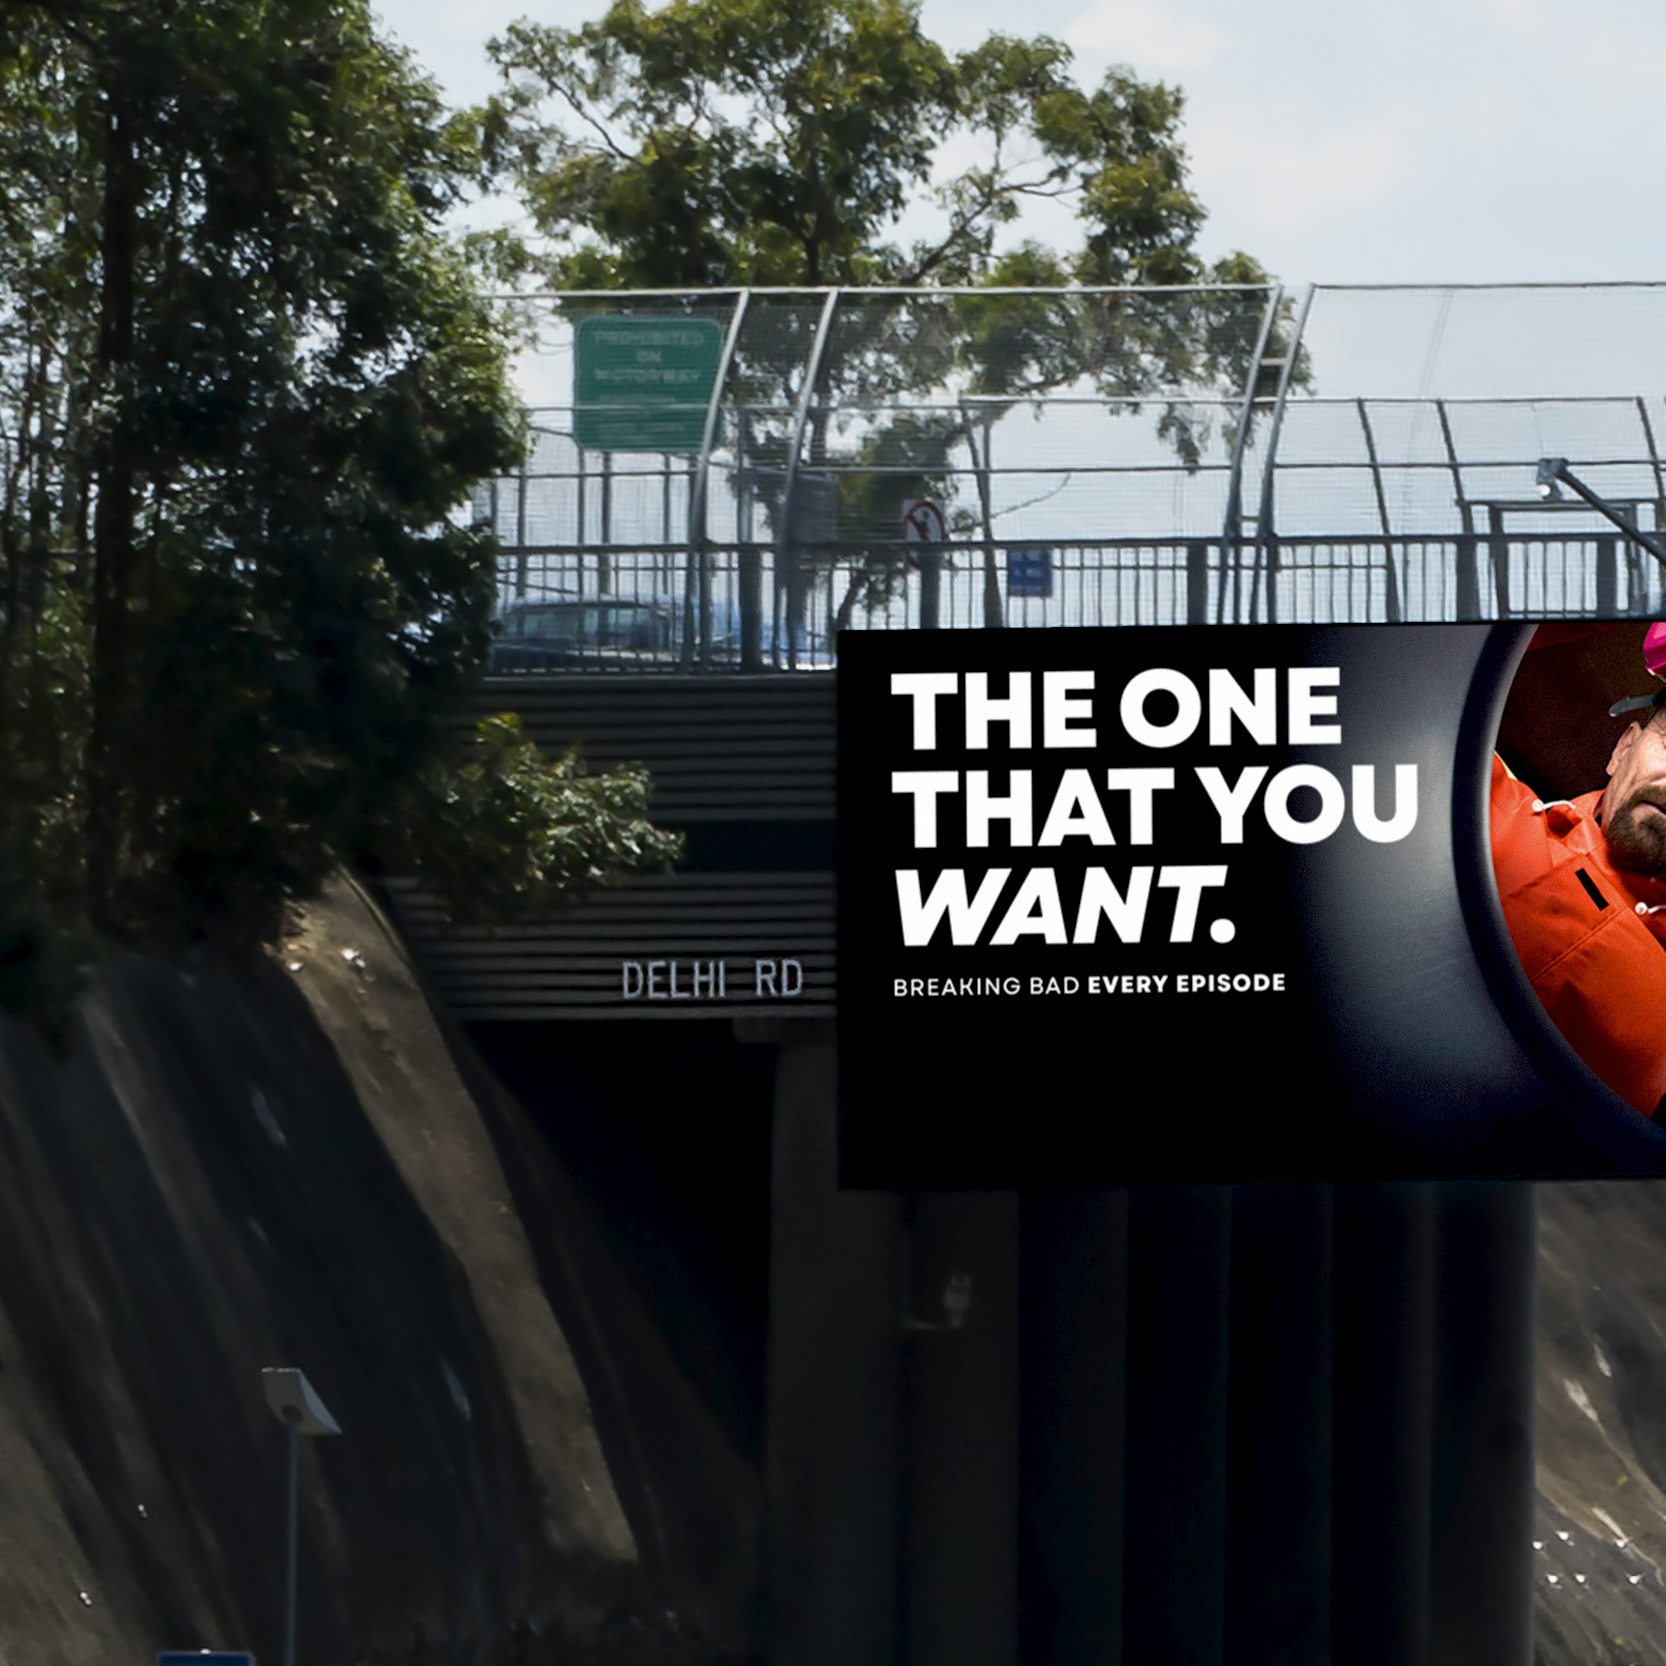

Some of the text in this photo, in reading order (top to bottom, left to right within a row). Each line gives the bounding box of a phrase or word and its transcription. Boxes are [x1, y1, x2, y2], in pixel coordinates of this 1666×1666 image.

[890, 667, 1343, 751] THE ONE
[891, 763, 1419, 849] THAT YOU
[894, 864, 1237, 947] WANT.
[622, 959, 803, 999] DELHI RD
[893, 973, 1286, 997] BREAKING BAD EVERY EPISODE
